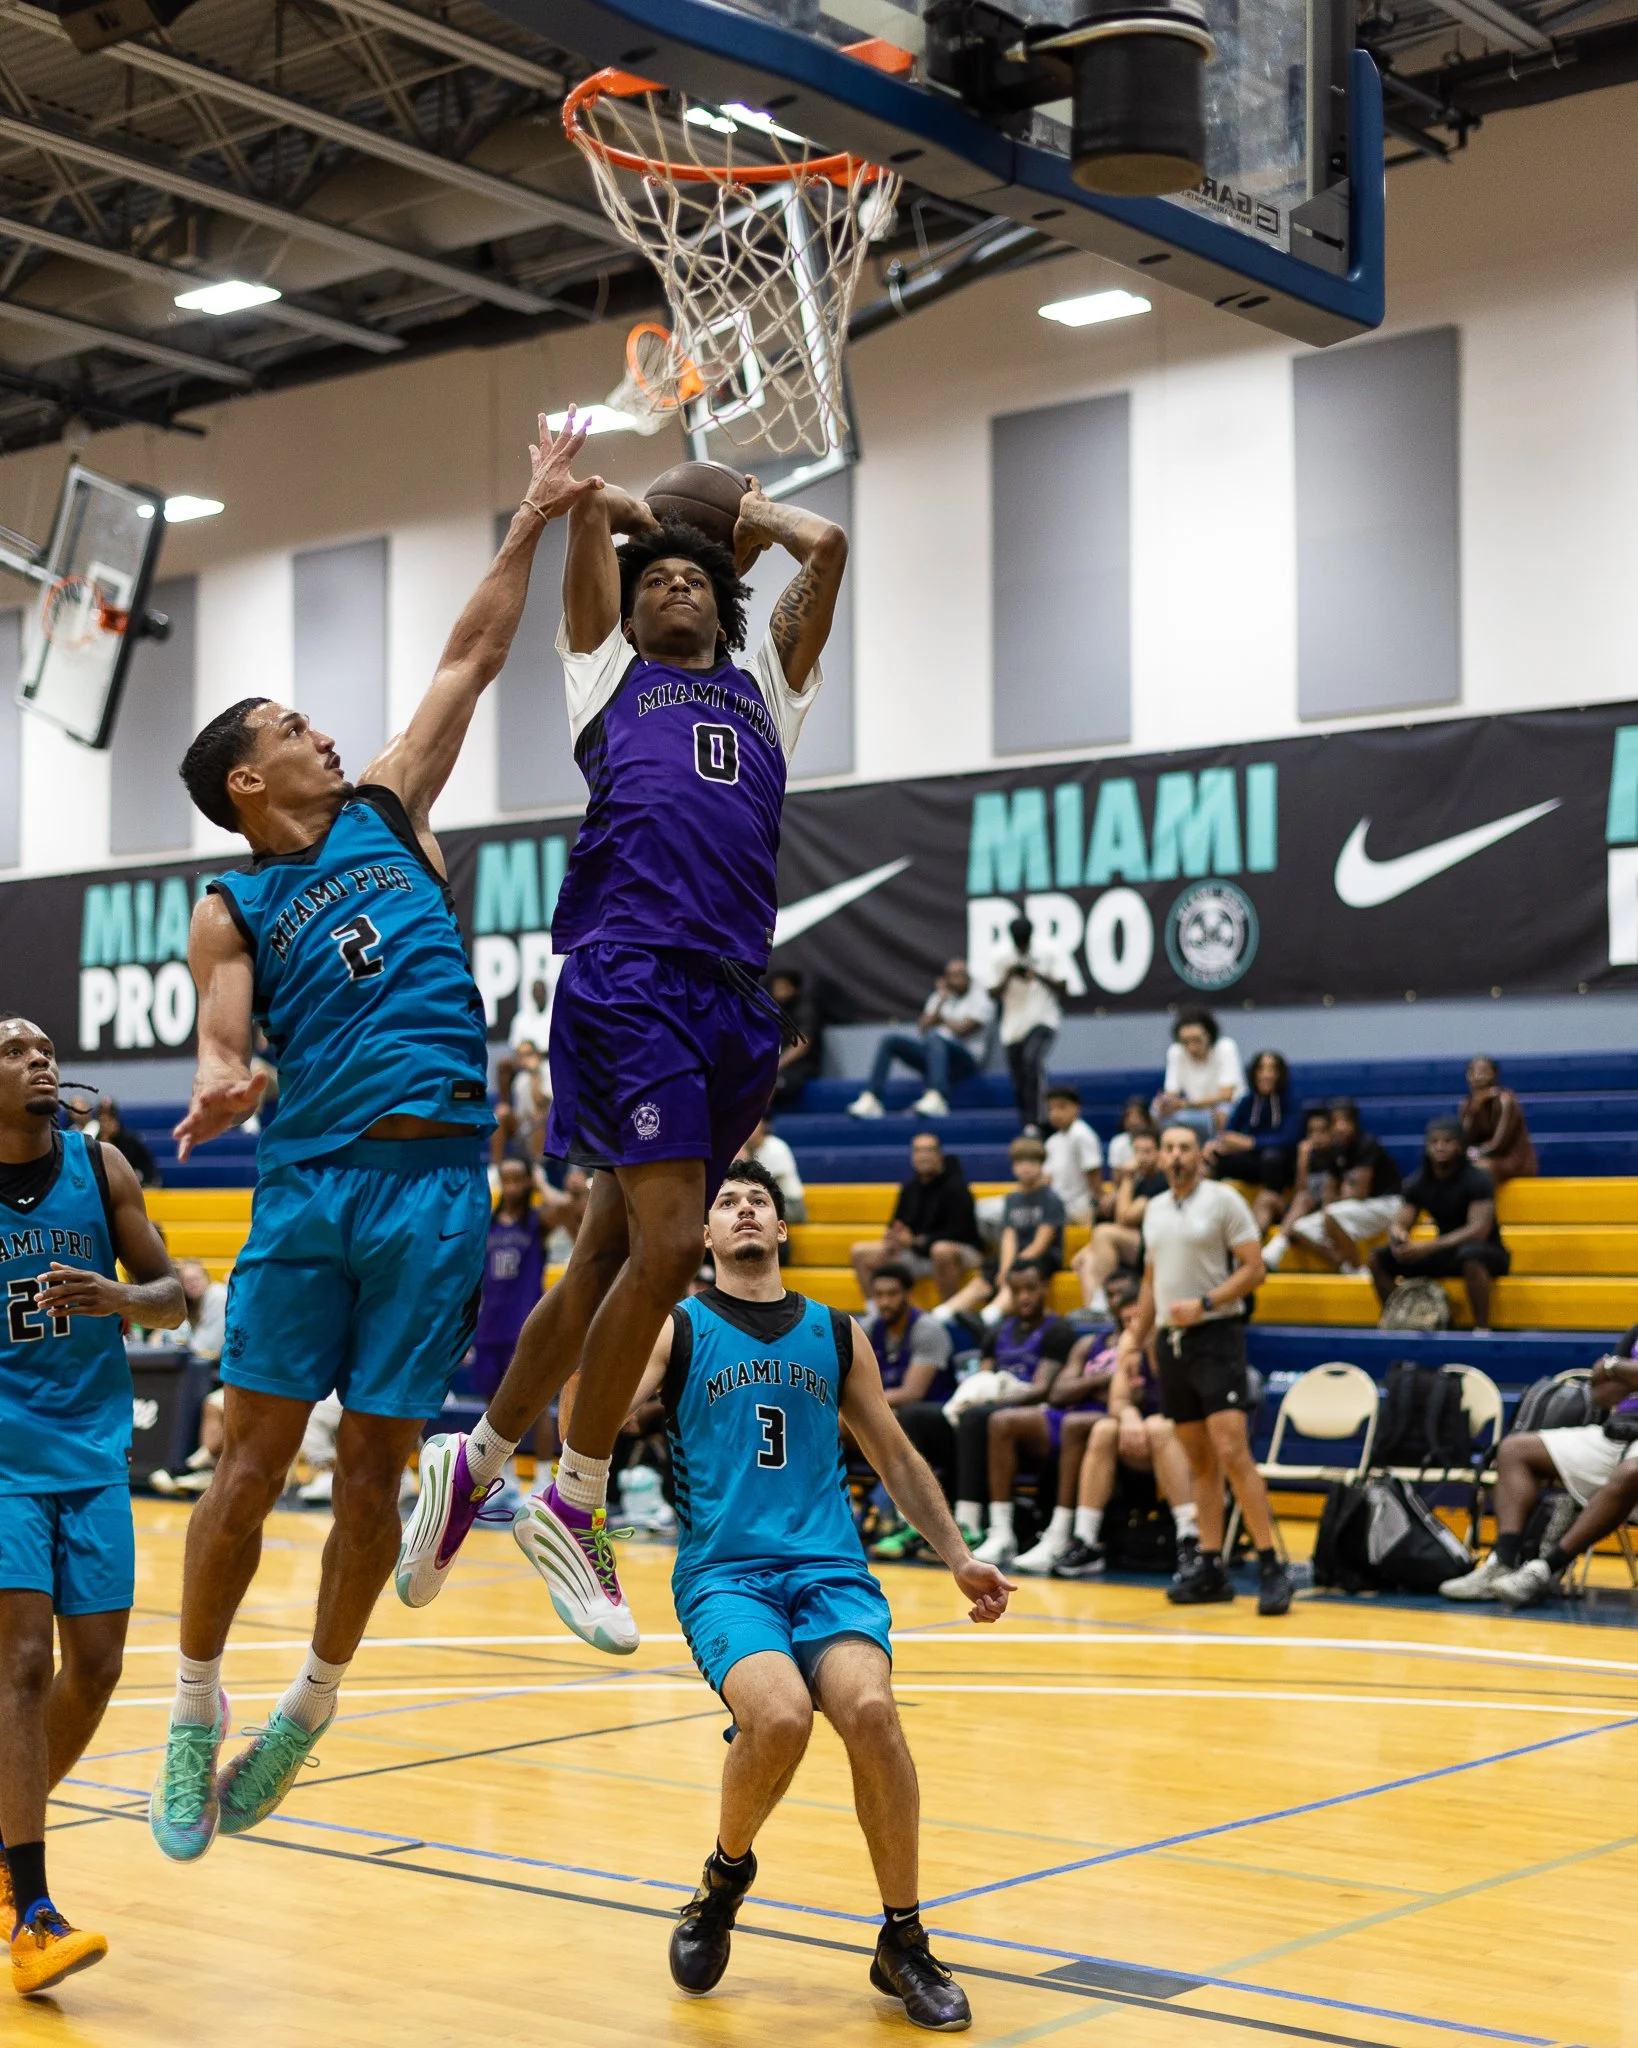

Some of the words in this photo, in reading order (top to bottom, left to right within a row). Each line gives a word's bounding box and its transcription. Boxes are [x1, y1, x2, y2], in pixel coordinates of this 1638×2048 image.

[638, 682, 728, 718] MIAMI
[692, 722, 740, 786] 0
[966, 761, 1279, 896] MIAMI
[80, 872, 216, 968] MIA
[270, 875, 350, 965] MIAMI
[345, 864, 414, 894] PRO
[473, 835, 570, 934] MI
[329, 913, 386, 982] 2
[966, 886, 1155, 997] PRO
[78, 960, 197, 1052] PRO
[49, 1228, 93, 1261] PRO
[705, 1359, 783, 1406] MIAMI
[788, 1361, 829, 1406] PRO
[755, 1403, 788, 1470] 3
